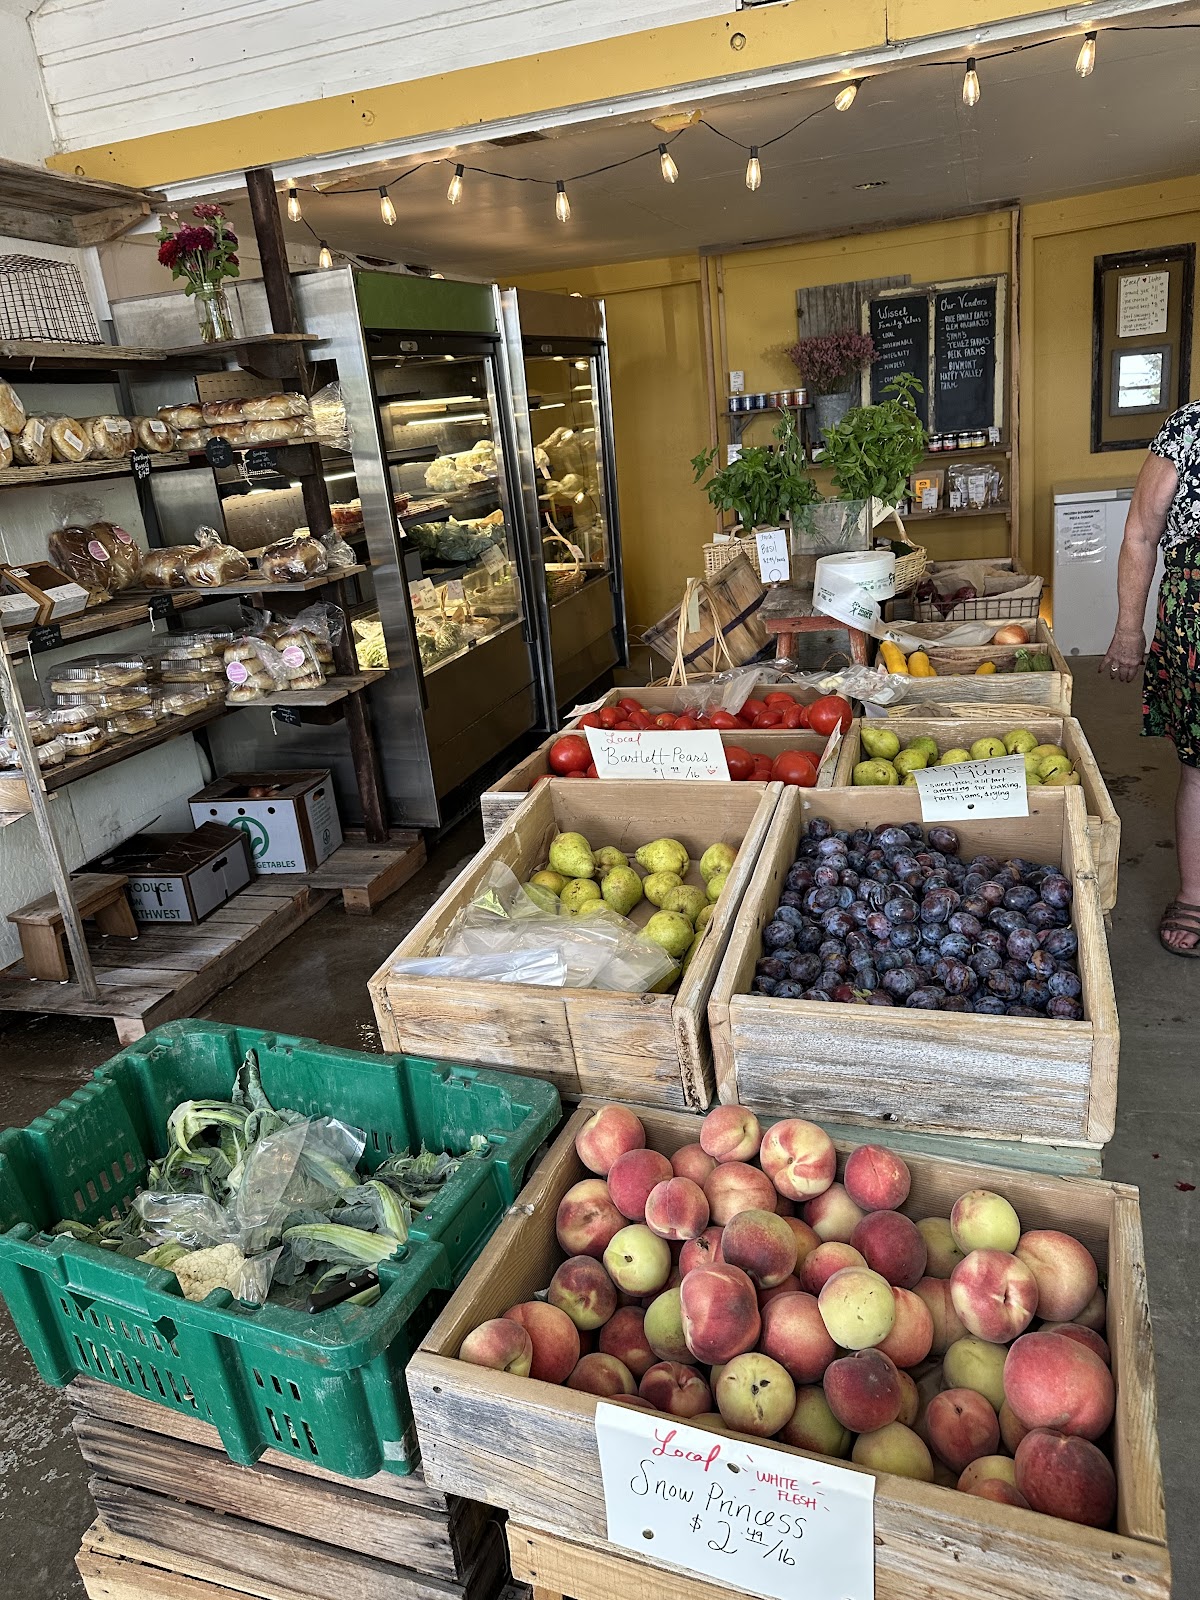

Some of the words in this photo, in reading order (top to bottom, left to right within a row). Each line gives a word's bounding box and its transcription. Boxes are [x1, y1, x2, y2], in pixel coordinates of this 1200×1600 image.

[940, 297, 956, 311] Our
[958, 292, 988, 309] Vendors
[877, 306, 908, 319] Wissel
[878, 319, 903, 329] Family
[970, 336, 991, 348] FARMS
[964, 346, 986, 357] FARMS
[940, 371, 958, 381] HAPPY
[960, 368, 983, 379] VALLEY
[761, 541, 777, 554] Basil
[604, 732, 642, 745] Local
[601, 746, 670, 765] Bartlett
[672, 746, 709, 763] Pears
[933, 786, 970, 794] amazing
[652, 1428, 721, 1472] Local
[756, 1470, 799, 1490] WHITE
[630, 1459, 695, 1504] Snow
[705, 1481, 807, 1539] Princess
[777, 1489, 817, 1511] FLESH
